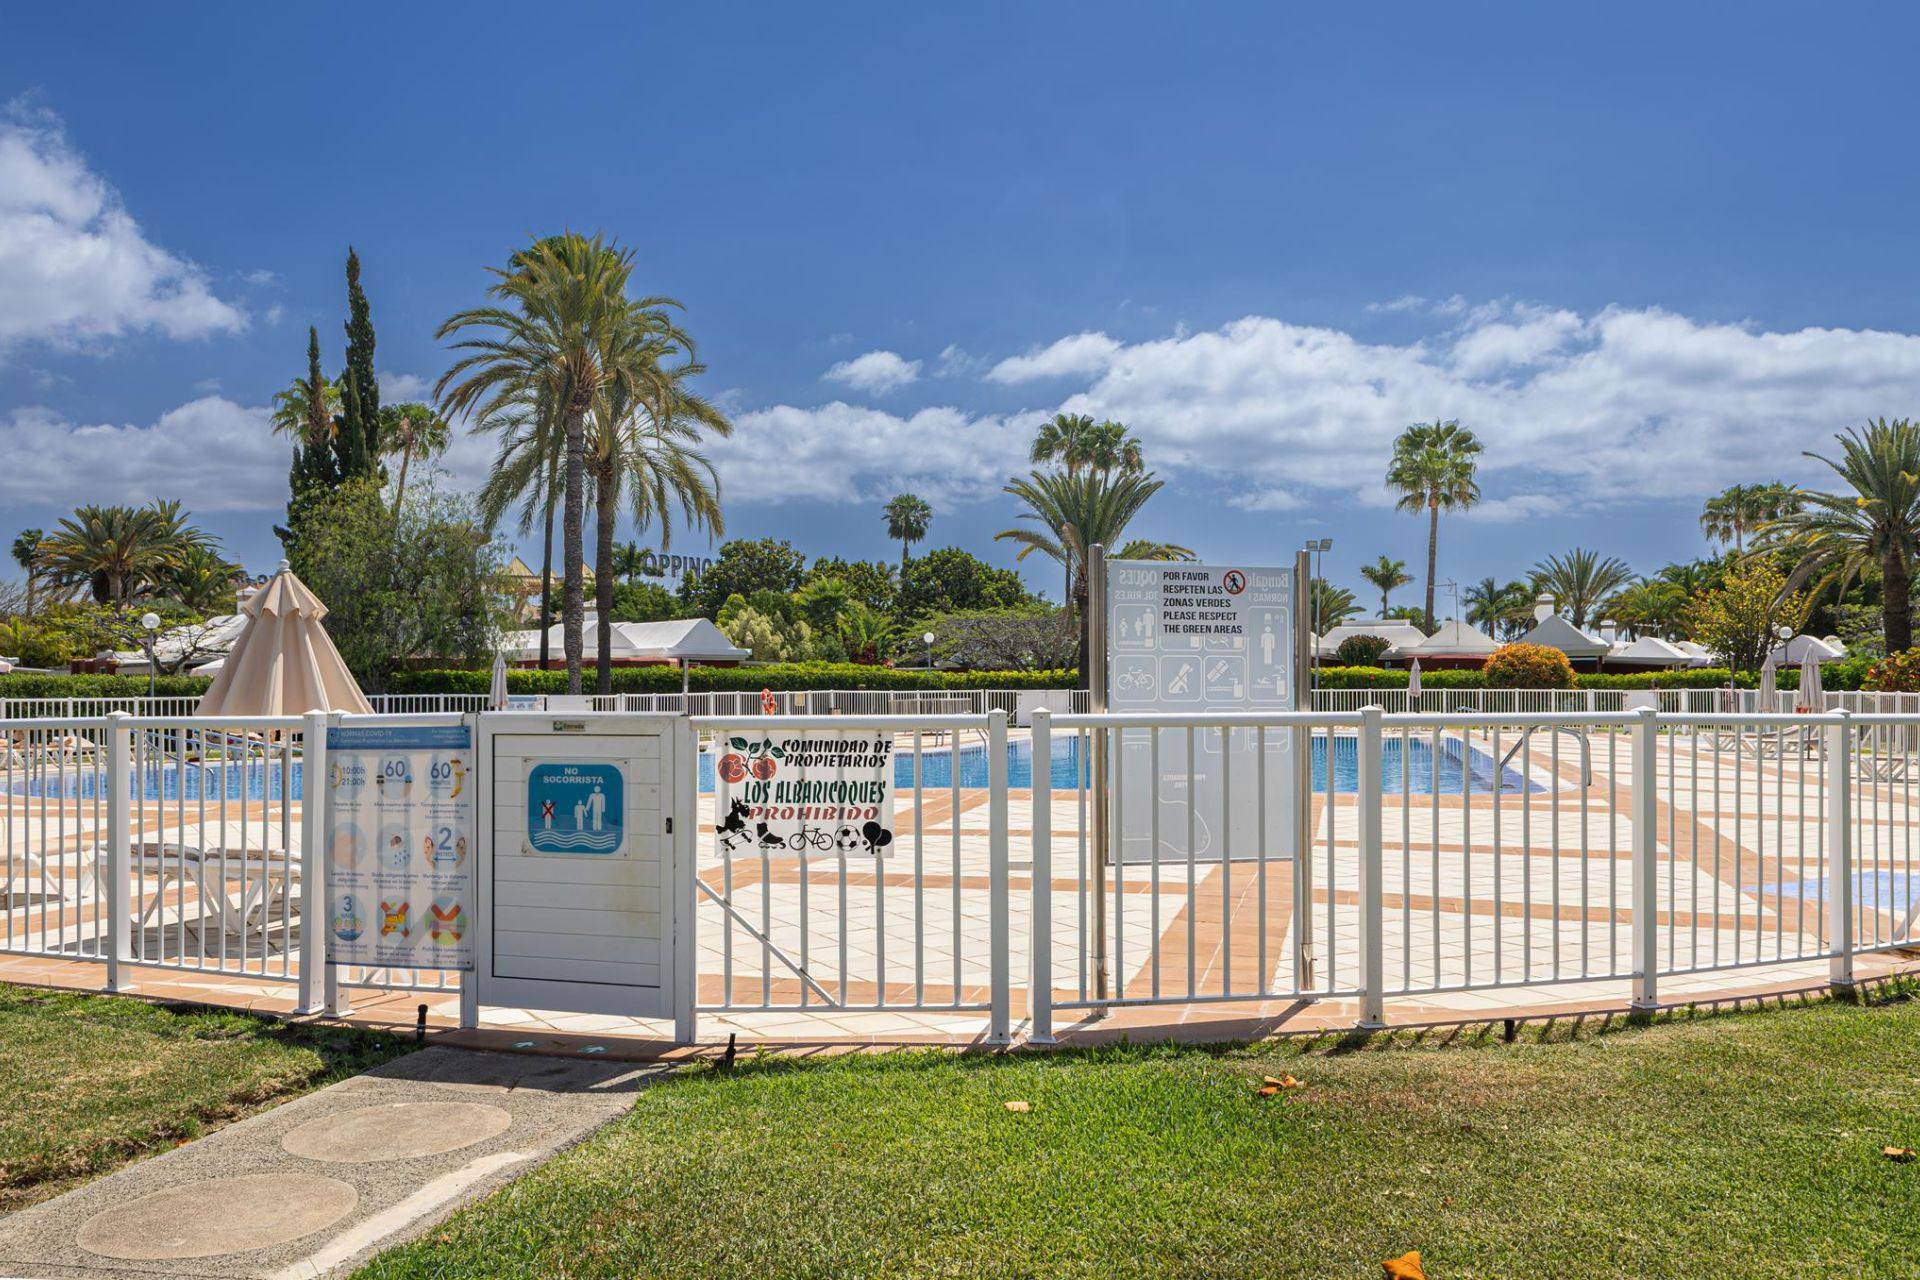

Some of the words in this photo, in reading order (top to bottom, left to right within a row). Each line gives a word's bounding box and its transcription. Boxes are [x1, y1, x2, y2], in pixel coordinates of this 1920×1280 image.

[1163, 572, 1180, 581] POR
[1182, 572, 1209, 581] FAVOR
[1163, 585, 1205, 594] RESPETEN
[1207, 586, 1223, 595] LAS
[1163, 598, 1194, 607] ZONAS
[1196, 598, 1231, 608] VERDES
[1163, 611, 1196, 621] PLEASE
[1198, 612, 1237, 621] RESPECT
[1163, 624, 1181, 633] THE
[1182, 624, 1212, 634] GREEN
[1213, 625, 1242, 634] AREAS
[781, 740, 869, 753] COMUNIDAD
[873, 740, 892, 754] DE
[784, 754, 887, 768] PROPIETARIOS
[342, 766, 365, 775] 10:00h
[385, 761, 405, 777] 60
[430, 762, 451, 779] 60
[564, 767, 578, 775] NO
[342, 778, 365, 786] 21:00h
[543, 776, 604, 785] SOCORRISTA
[744, 780, 771, 804] LOS
[775, 780, 886, 805] ALBARICOQUES
[748, 806, 879, 820] PROHIBIDO
[438, 827, 452, 850] 2
[343, 896, 352, 912] 3
